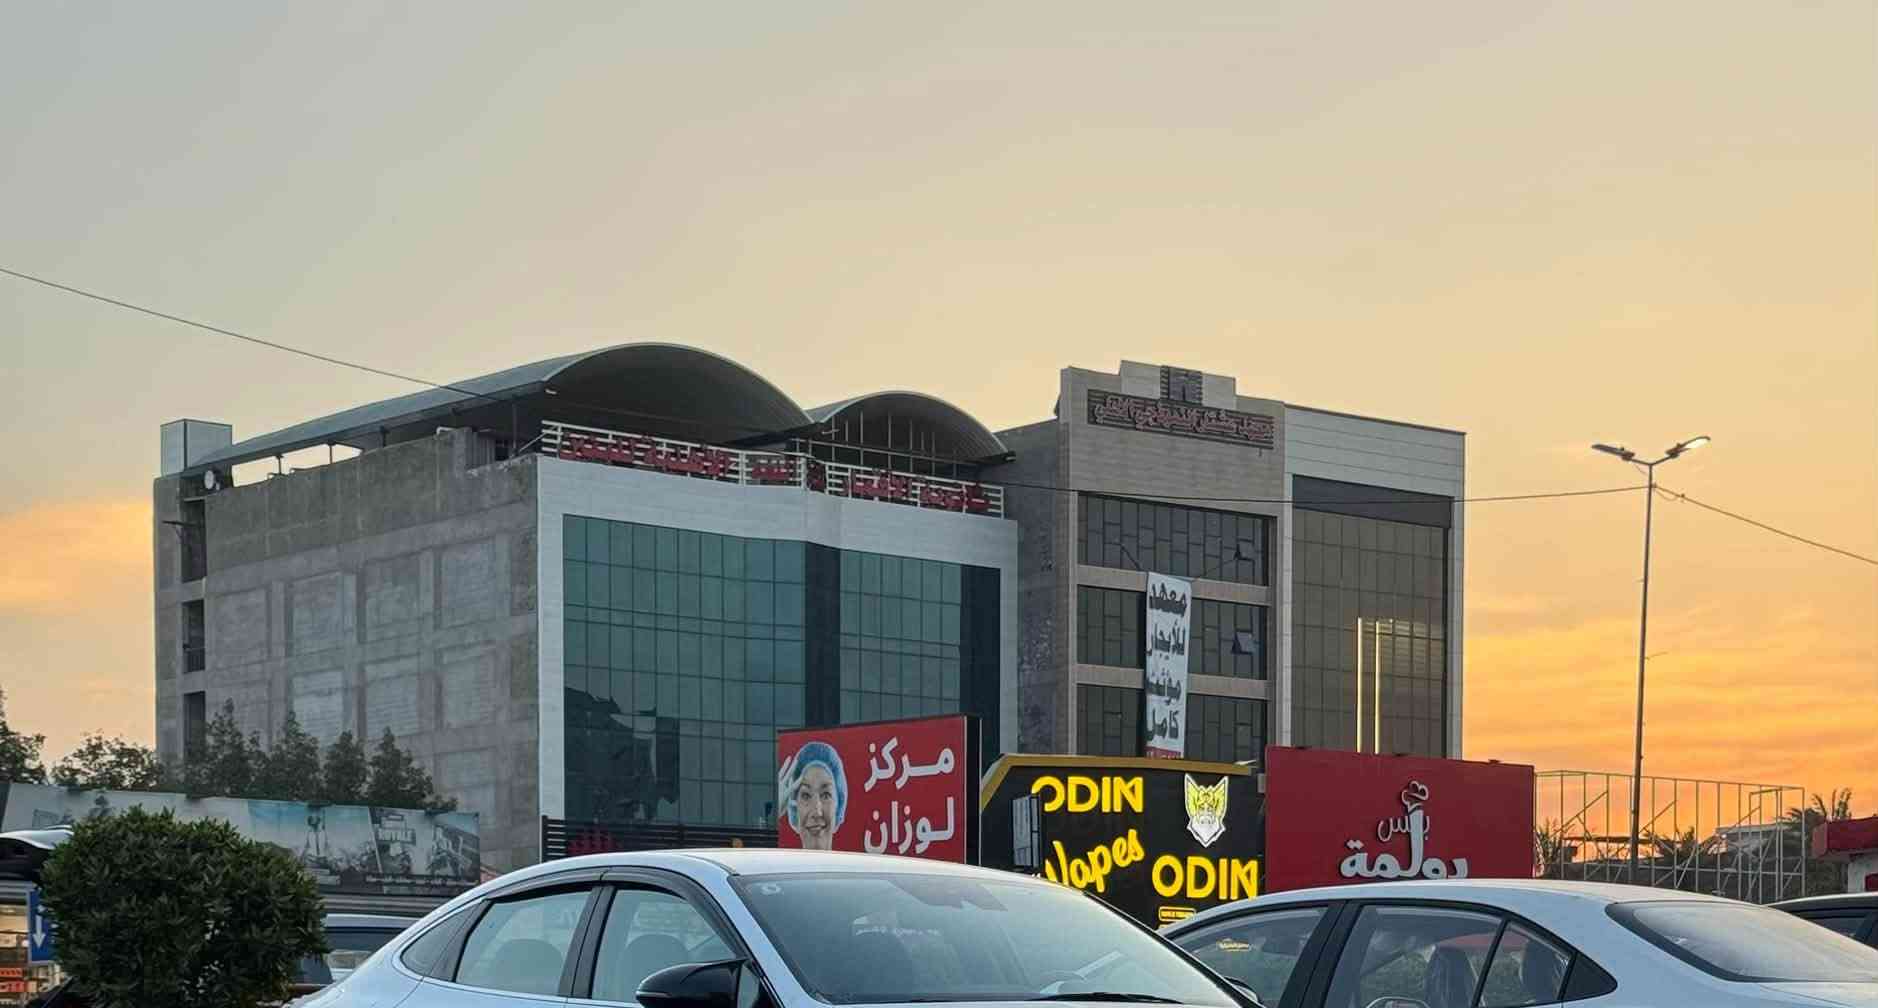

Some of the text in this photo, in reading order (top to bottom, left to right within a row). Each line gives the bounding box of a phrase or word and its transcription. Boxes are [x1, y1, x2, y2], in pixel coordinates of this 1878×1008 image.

[1147, 710, 1179, 741] كامل
[864, 737, 954, 792] مركز
[1031, 775, 1144, 813] ODIN
[864, 796, 954, 854] لوزان
[1151, 854, 1258, 900] ODIN
